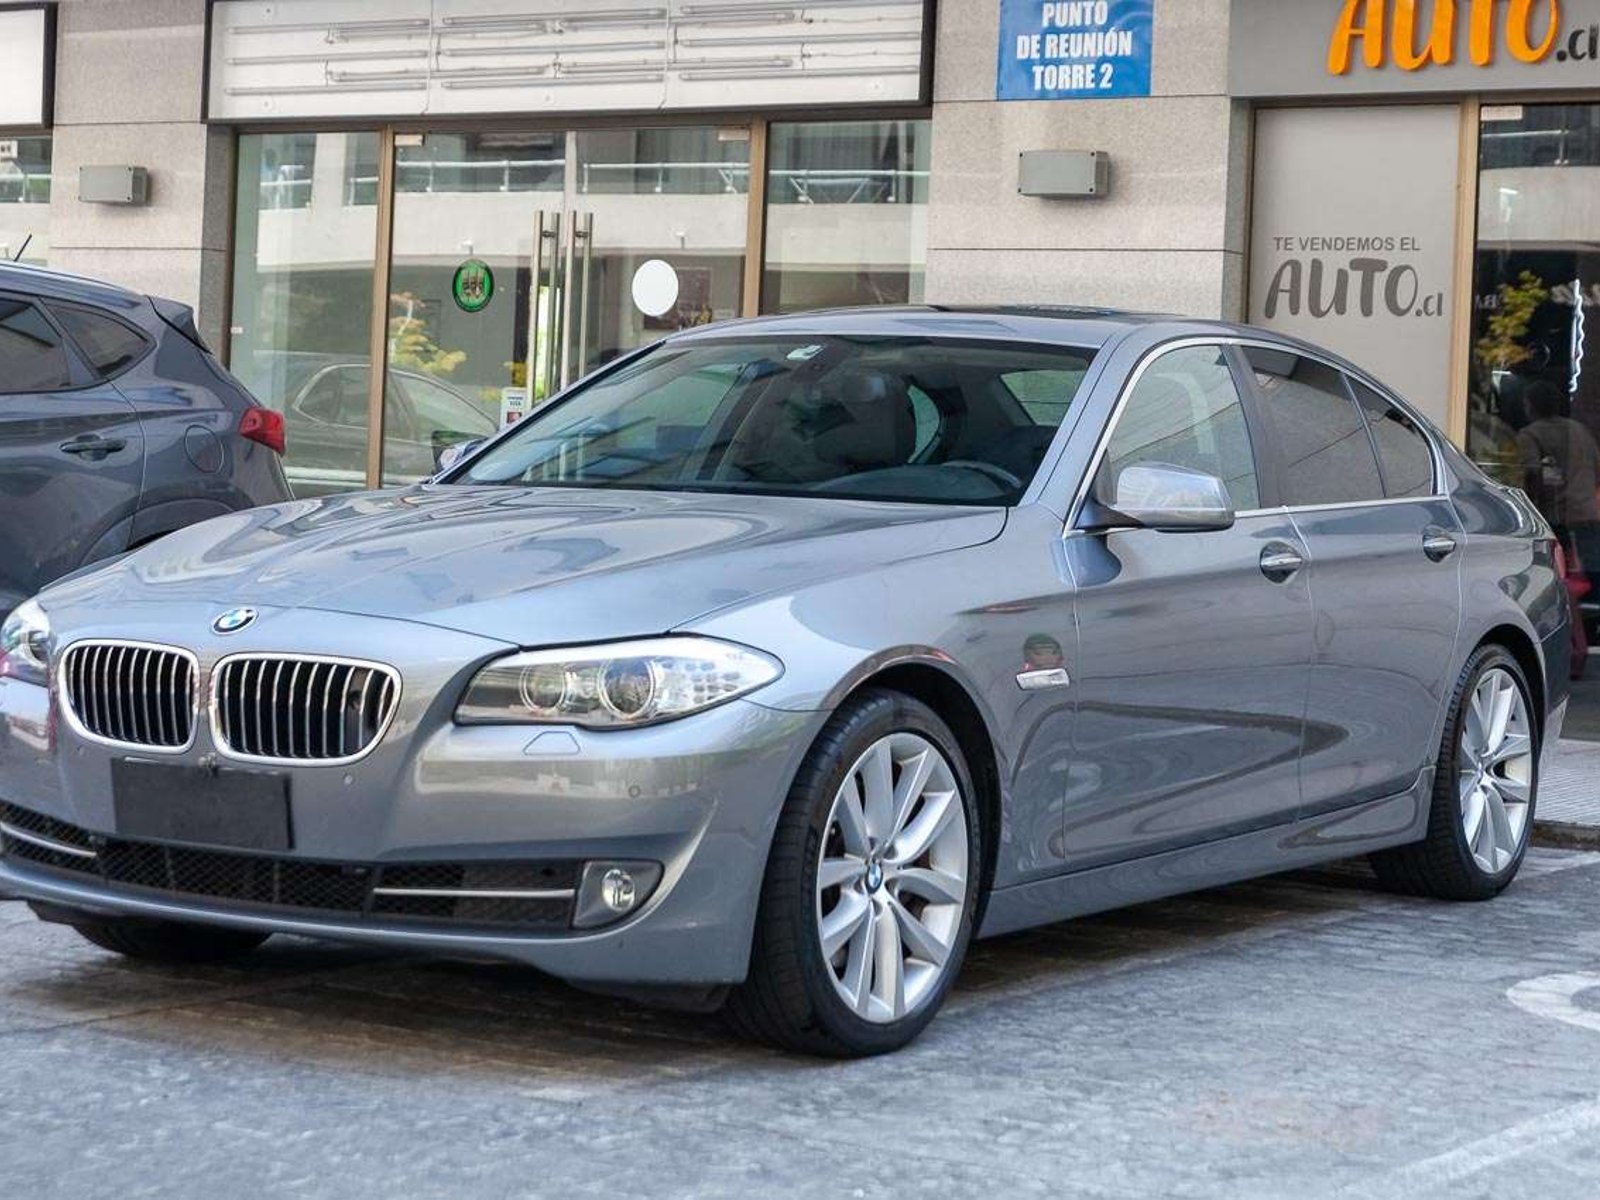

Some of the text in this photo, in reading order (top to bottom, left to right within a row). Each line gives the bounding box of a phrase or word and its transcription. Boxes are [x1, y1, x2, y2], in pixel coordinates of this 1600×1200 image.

[1042, 0, 1108, 27] PUNTO
[1017, 27, 1133, 59] DE REUNIÓN
[1032, 63, 1114, 90] TORRE 2
[1273, 236, 1421, 251] TE VENDEMOS EL
